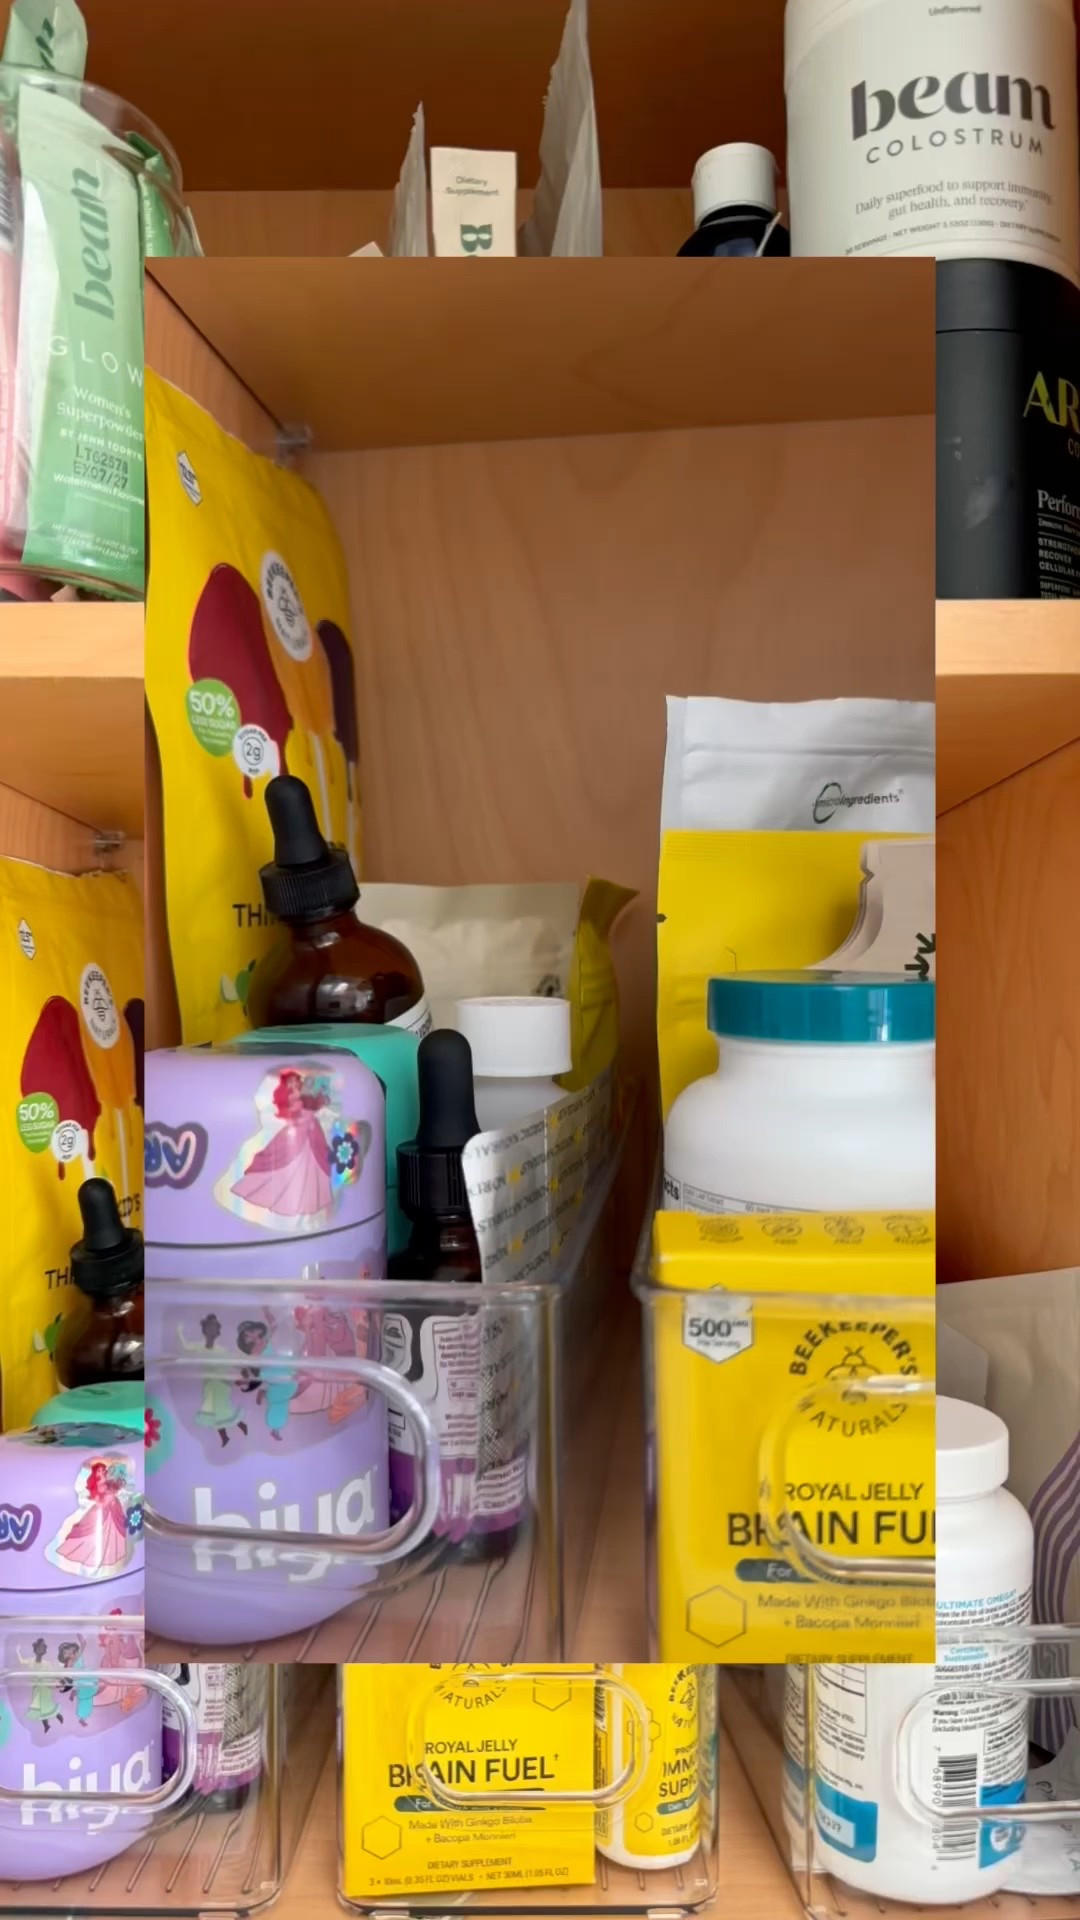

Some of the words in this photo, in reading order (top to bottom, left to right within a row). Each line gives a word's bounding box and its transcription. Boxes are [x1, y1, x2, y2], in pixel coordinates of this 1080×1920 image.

[851, 71, 1056, 141] beam
[866, 128, 1043, 164] COLOSTRUM
[456, 176, 488, 188] Dietary
[446, 187, 499, 197] Supplement
[855, 196, 883, 215] Daily
[886, 180, 944, 203] superfood
[946, 181, 959, 191] to
[962, 180, 1005, 192] support
[888, 204, 908, 220] gut
[910, 197, 950, 213] health,
[953, 194, 977, 206] and
[71, 168, 115, 321] beam
[460, 223, 493, 257] B
[49, 335, 144, 389] GLOW
[72, 384, 132, 419] Women's
[189, 690, 236, 718] 50%
[245, 742, 261, 760] 2g
[19, 1102, 55, 1121] 50%
[61, 1135, 74, 1147] 2g
[688, 1318, 731, 1337] 500
[714, 1338, 741, 1350] Serving
[789, 1321, 919, 1376] BEEKEEPER'S
[783, 1483, 856, 1501] ROYAL
[860, 1482, 925, 1501] JELLY
[193, 1468, 376, 1582] hiya
[874, 1510, 935, 1545] FU
[766, 1563, 793, 1579] For
[758, 1593, 800, 1608] Made
[805, 1594, 840, 1609] With
[843, 1594, 896, 1611] Ginkgo
[936, 1599, 984, 1611] ULTIMATE
[795, 1615, 849, 1631] Bacopa
[425, 1741, 473, 1755] ROYAL
[476, 1739, 518, 1752] JELLY
[21, 1749, 151, 1835] hiya
[415, 1799, 431, 1809] For
[408, 1820, 437, 1831] Made
[440, 1818, 464, 1829] With
[466, 1816, 500, 1829] Ginkgo
[502, 1815, 533, 1826] Biloba
[433, 1832, 470, 1844] Bacopa
[427, 1859, 459, 1870] DIETARY
[461, 1857, 512, 1868] SUPPLEMENT
[486, 1871, 501, 1880] NET
